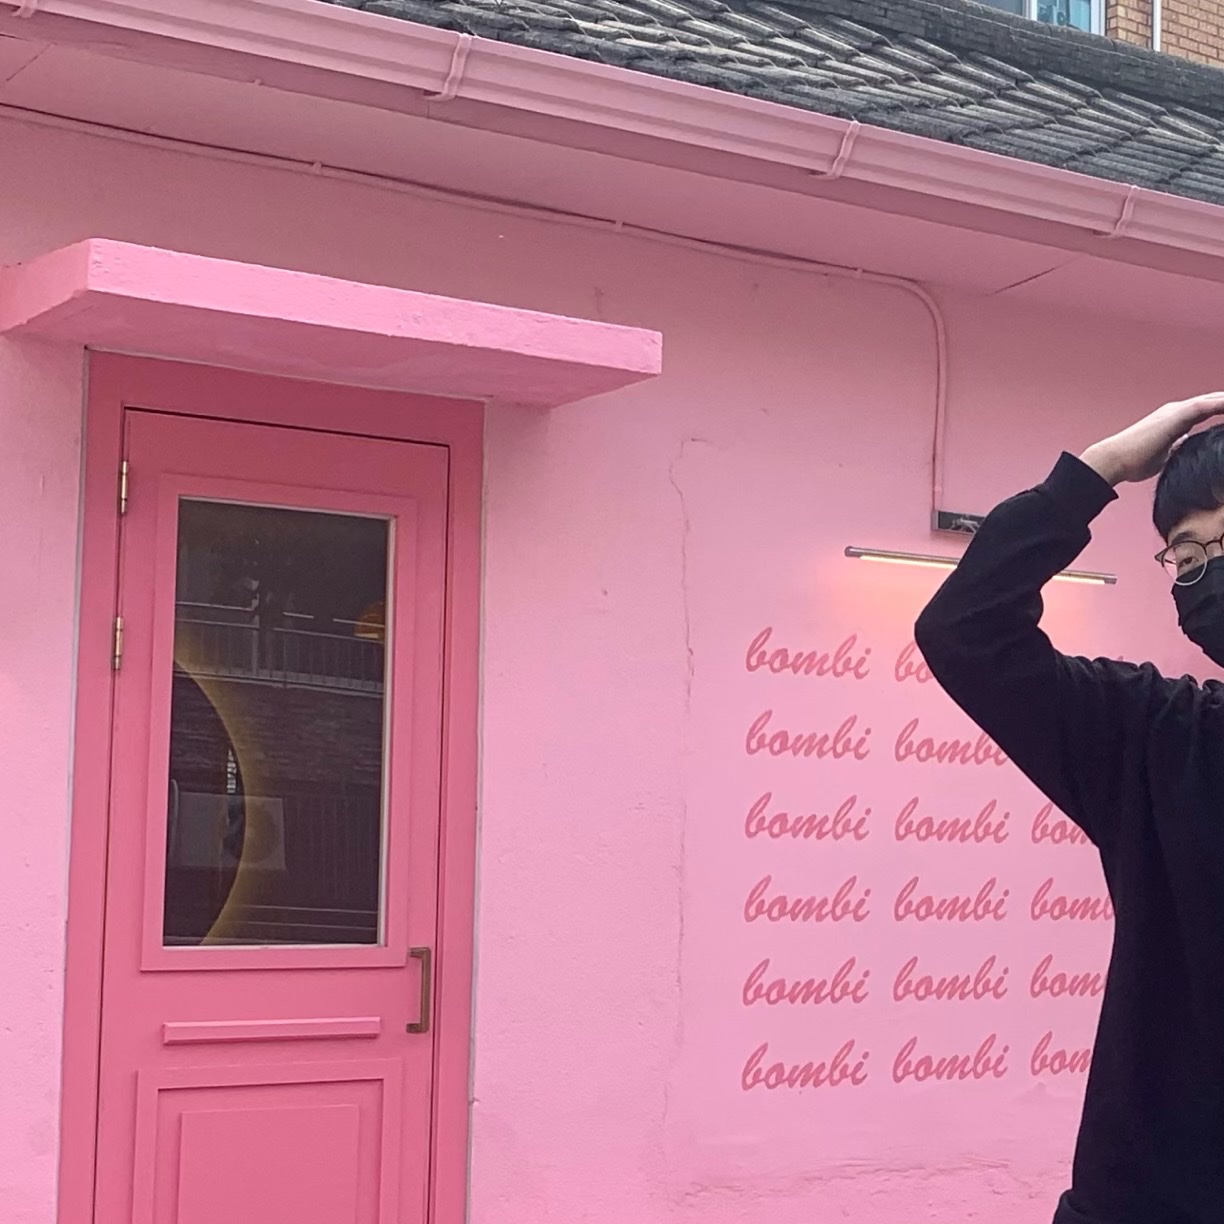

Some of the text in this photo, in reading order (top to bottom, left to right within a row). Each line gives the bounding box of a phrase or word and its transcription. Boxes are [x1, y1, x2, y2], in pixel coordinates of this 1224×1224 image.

[745, 626, 871, 680] bombi
[745, 709, 872, 761] bombi
[744, 791, 872, 841] bombi
[894, 796, 1011, 844] bombi
[743, 874, 872, 923] bombi
[893, 876, 1010, 923] bombi
[742, 953, 1106, 1007] bombi bombi bom
[741, 1039, 870, 1092] bombi
[892, 1033, 1010, 1084] bombi
